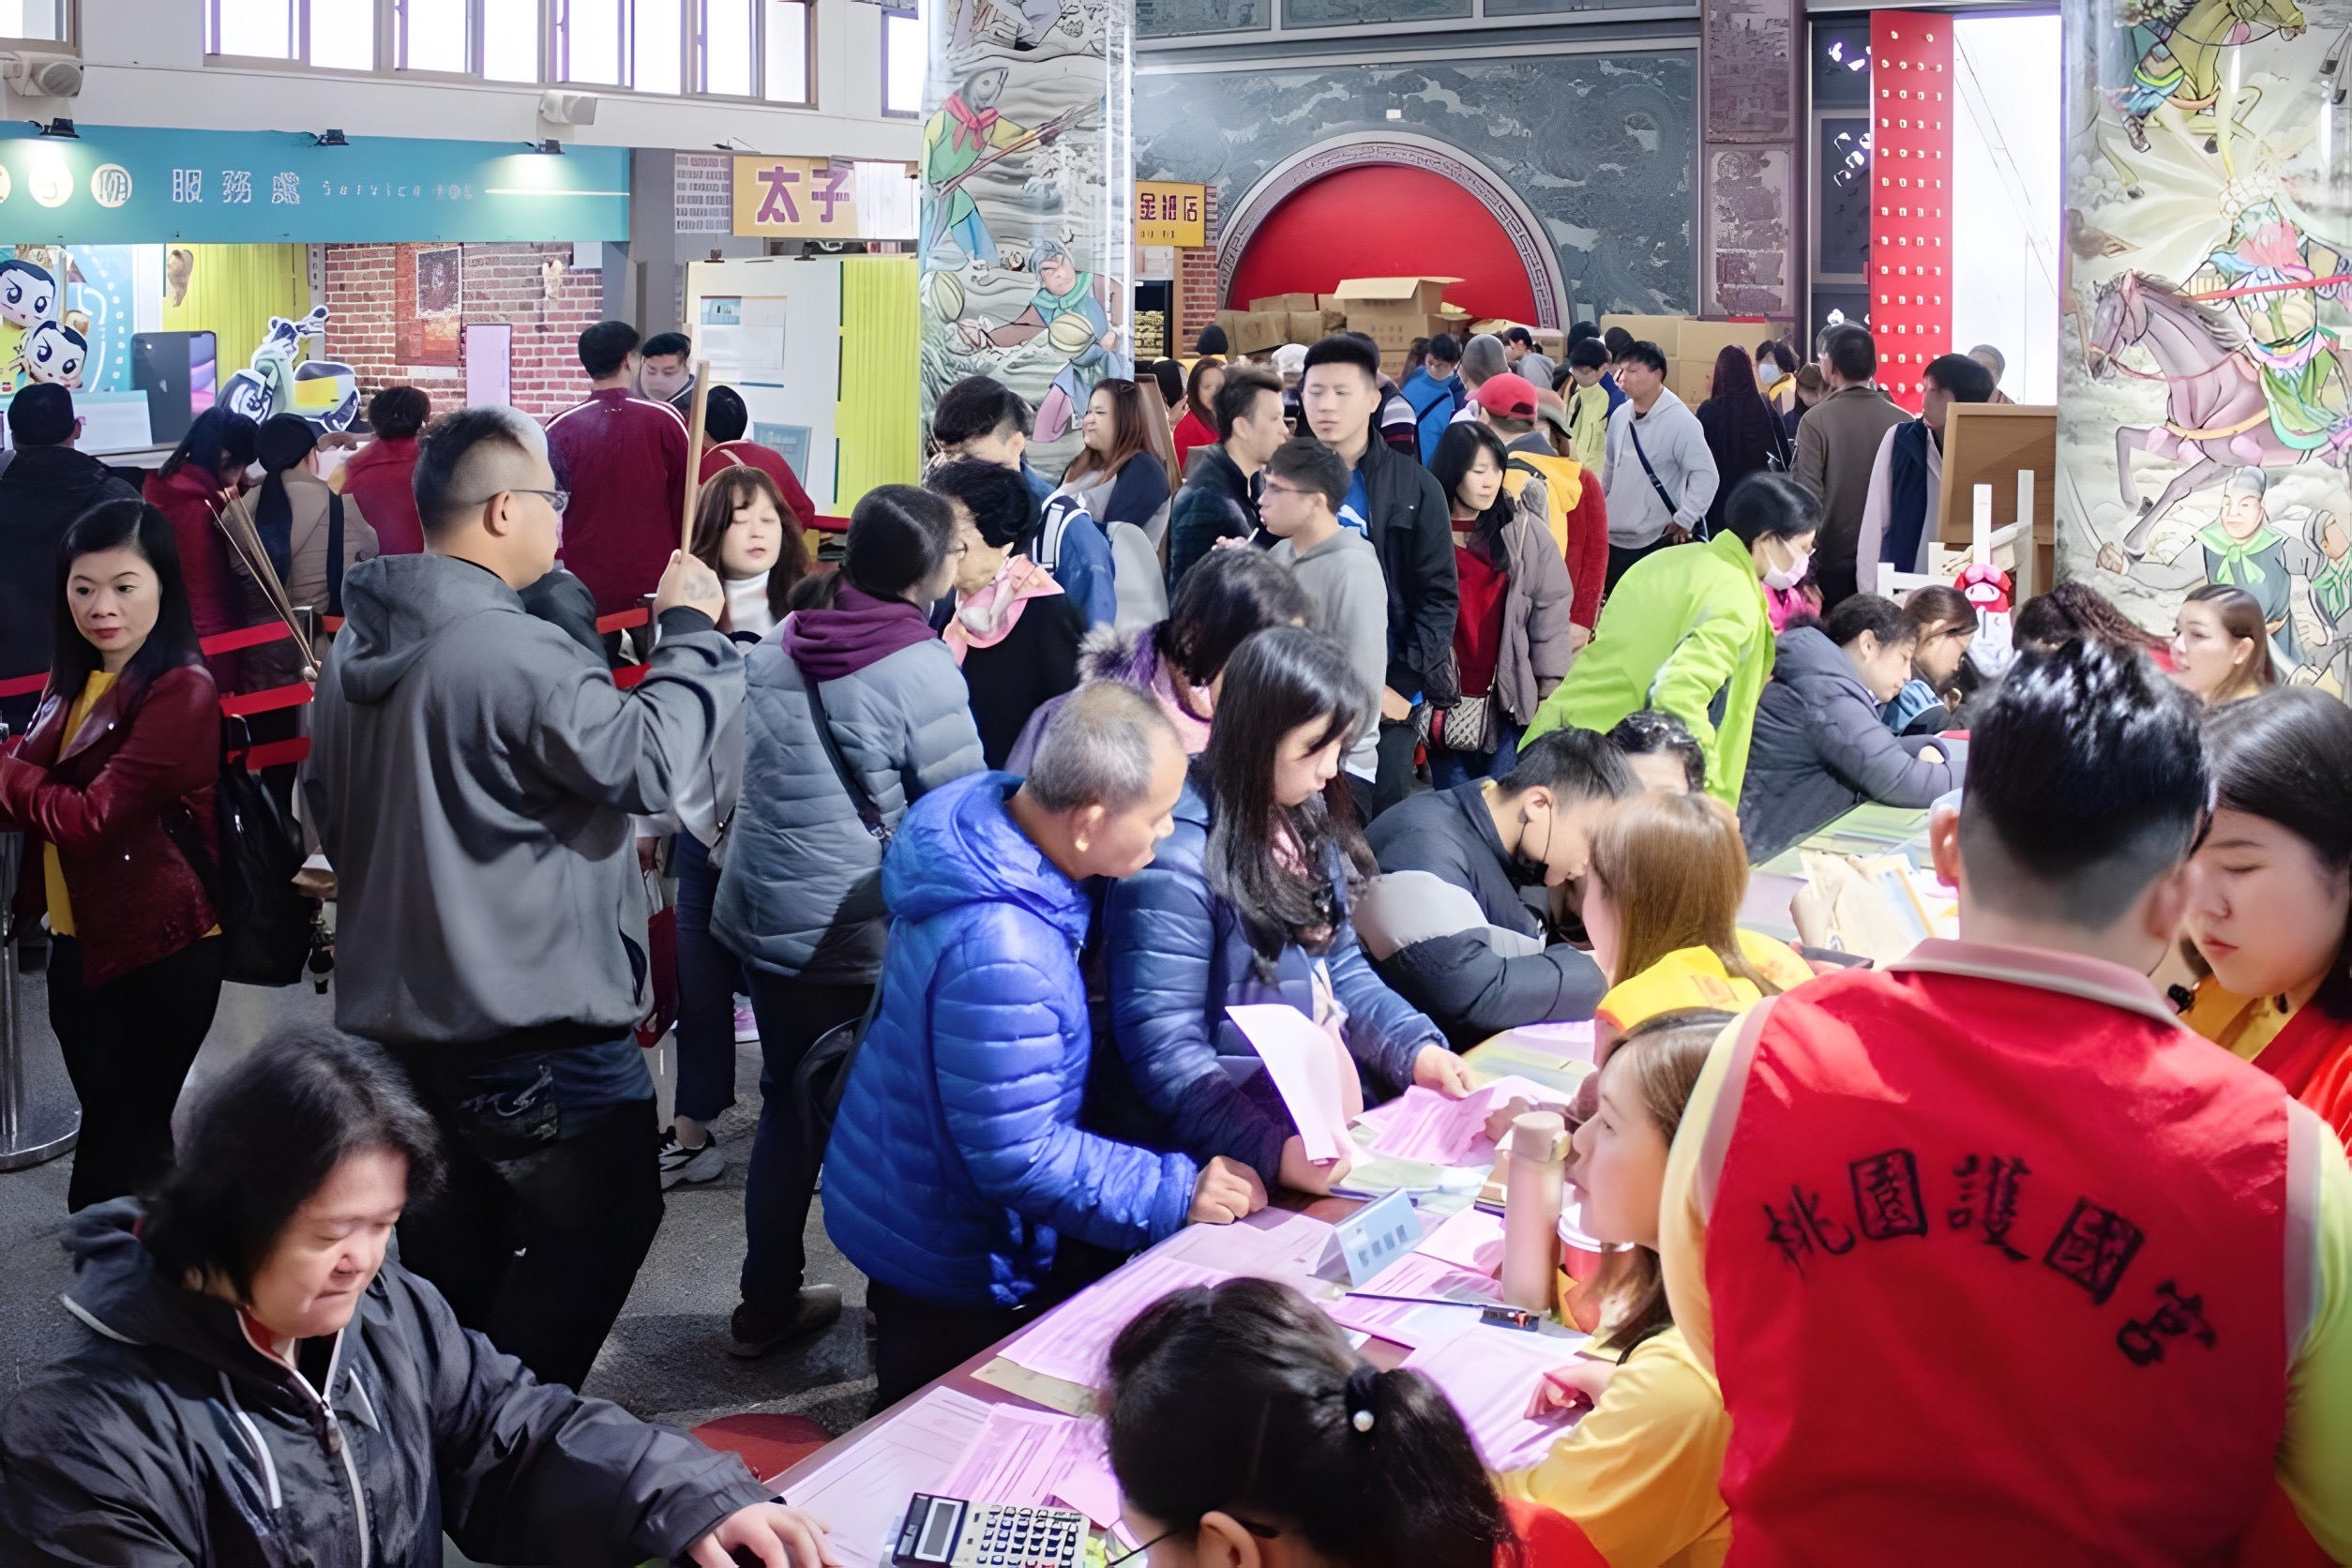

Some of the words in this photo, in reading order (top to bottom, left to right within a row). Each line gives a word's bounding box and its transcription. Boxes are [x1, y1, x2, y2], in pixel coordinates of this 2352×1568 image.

[756, 166, 851, 223] 太子
[1762, 1148, 2218, 1367] 桃園護國宮
